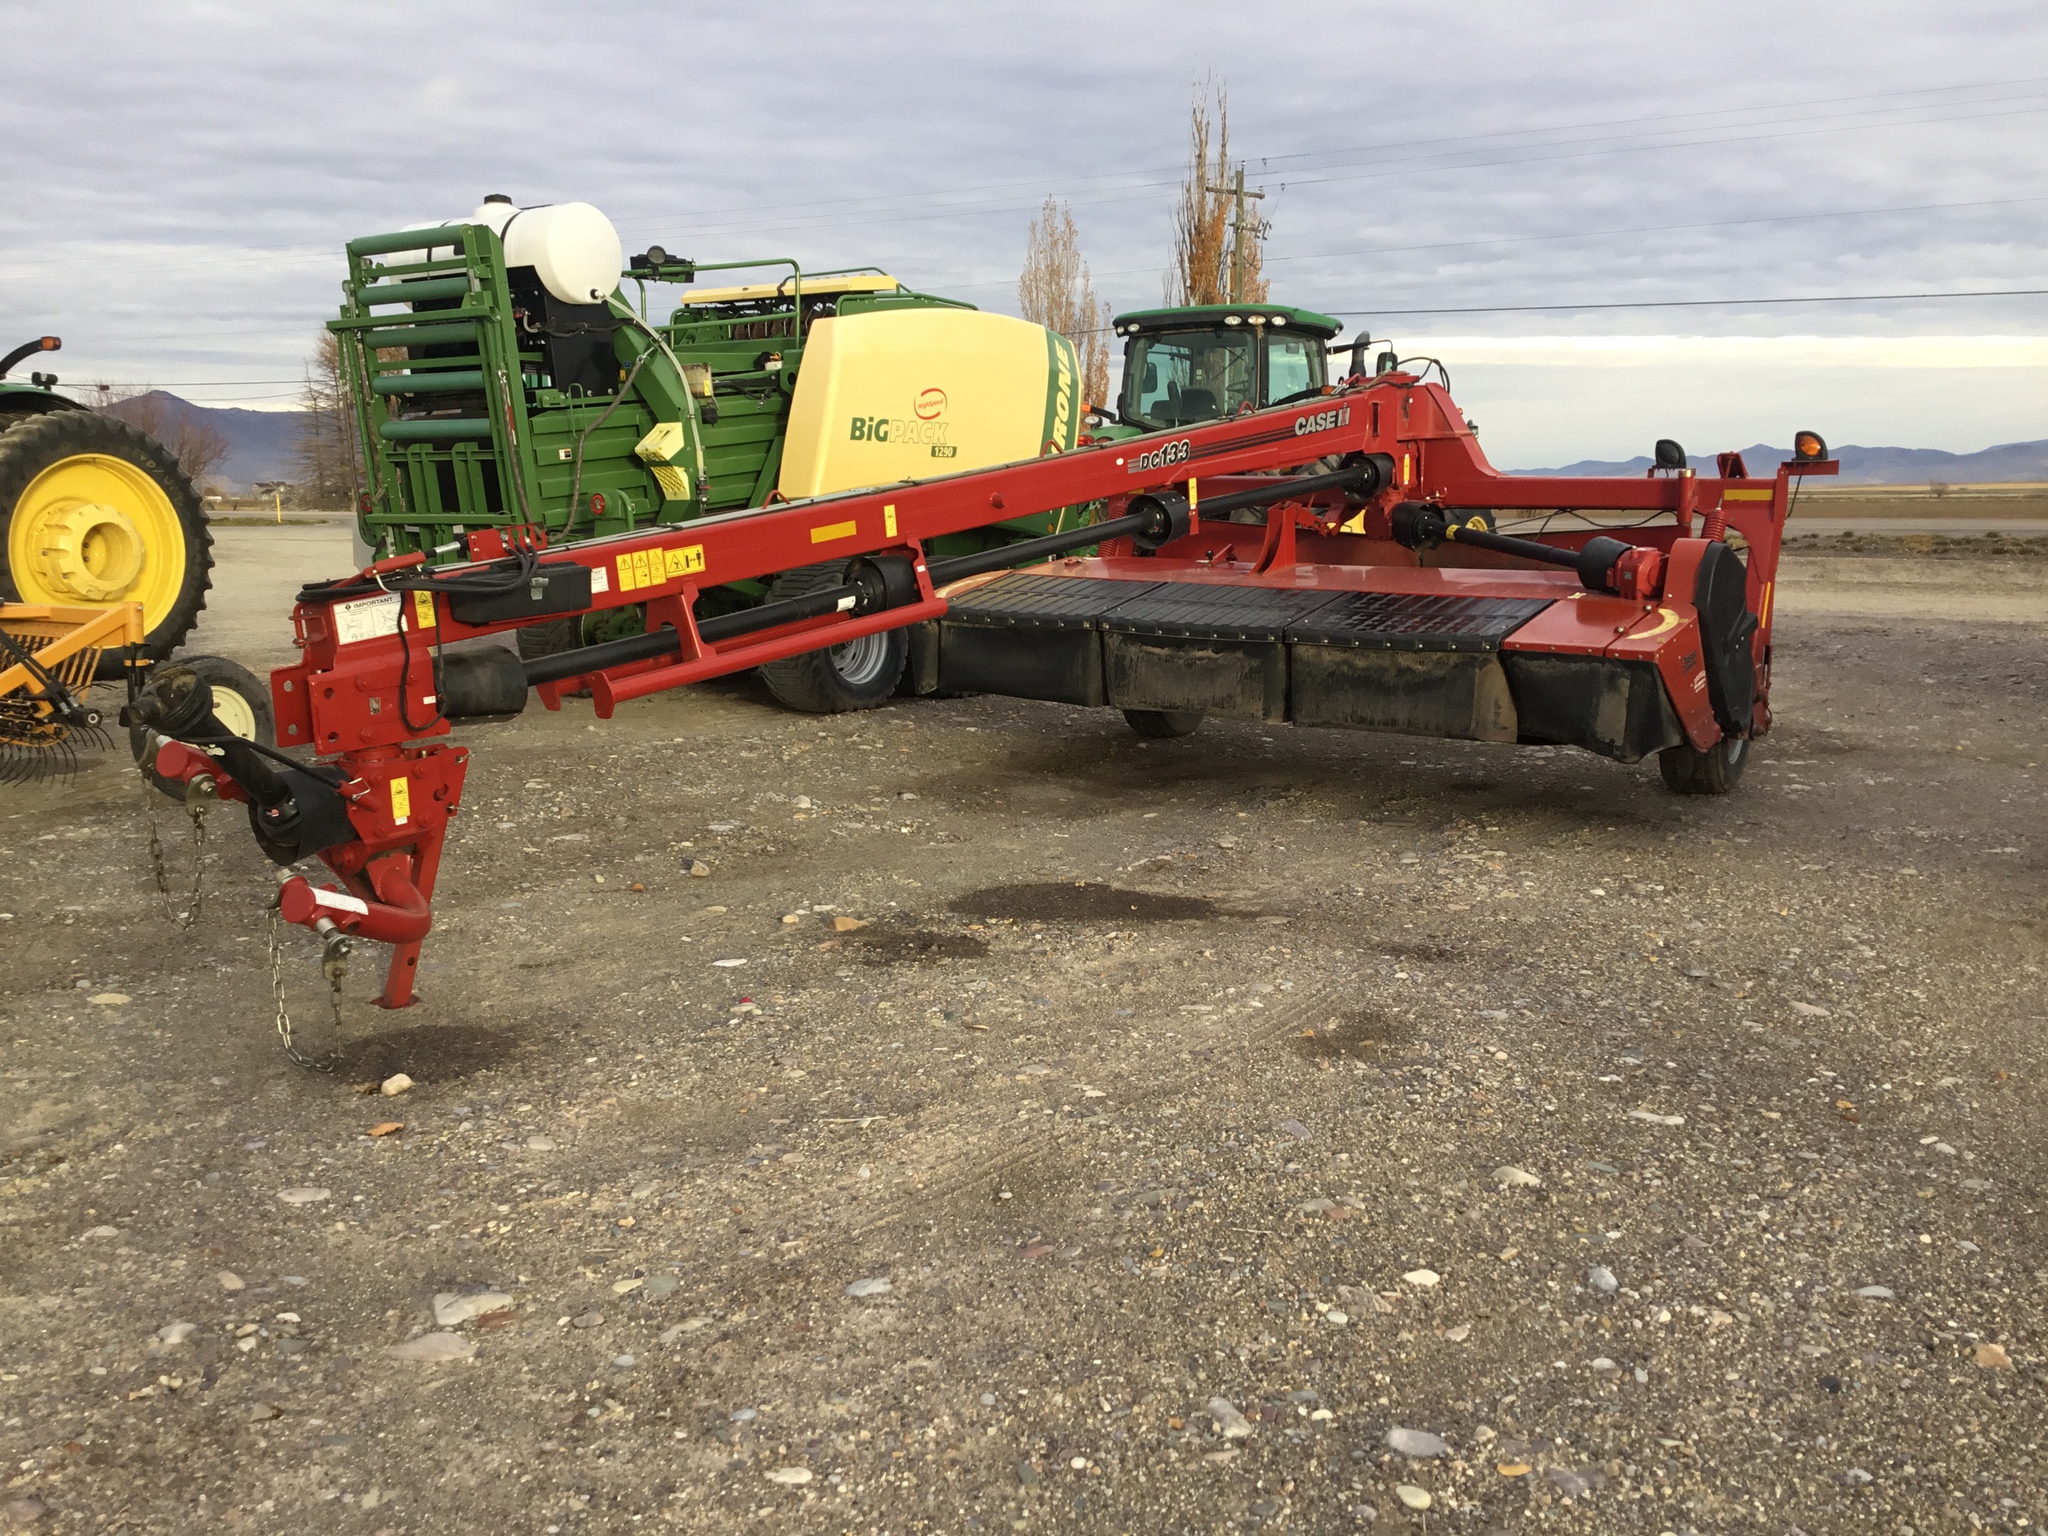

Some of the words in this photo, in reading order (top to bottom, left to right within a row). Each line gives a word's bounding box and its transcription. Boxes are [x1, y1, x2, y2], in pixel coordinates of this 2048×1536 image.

[917, 398, 944, 410] HighSpeed
[1051, 338, 1071, 454] RONE
[1294, 410, 1337, 436] CASE
[934, 447, 953, 457] 1290
[1140, 439, 1190, 470] DC133
[353, 596, 393, 609] IMPORTANT
